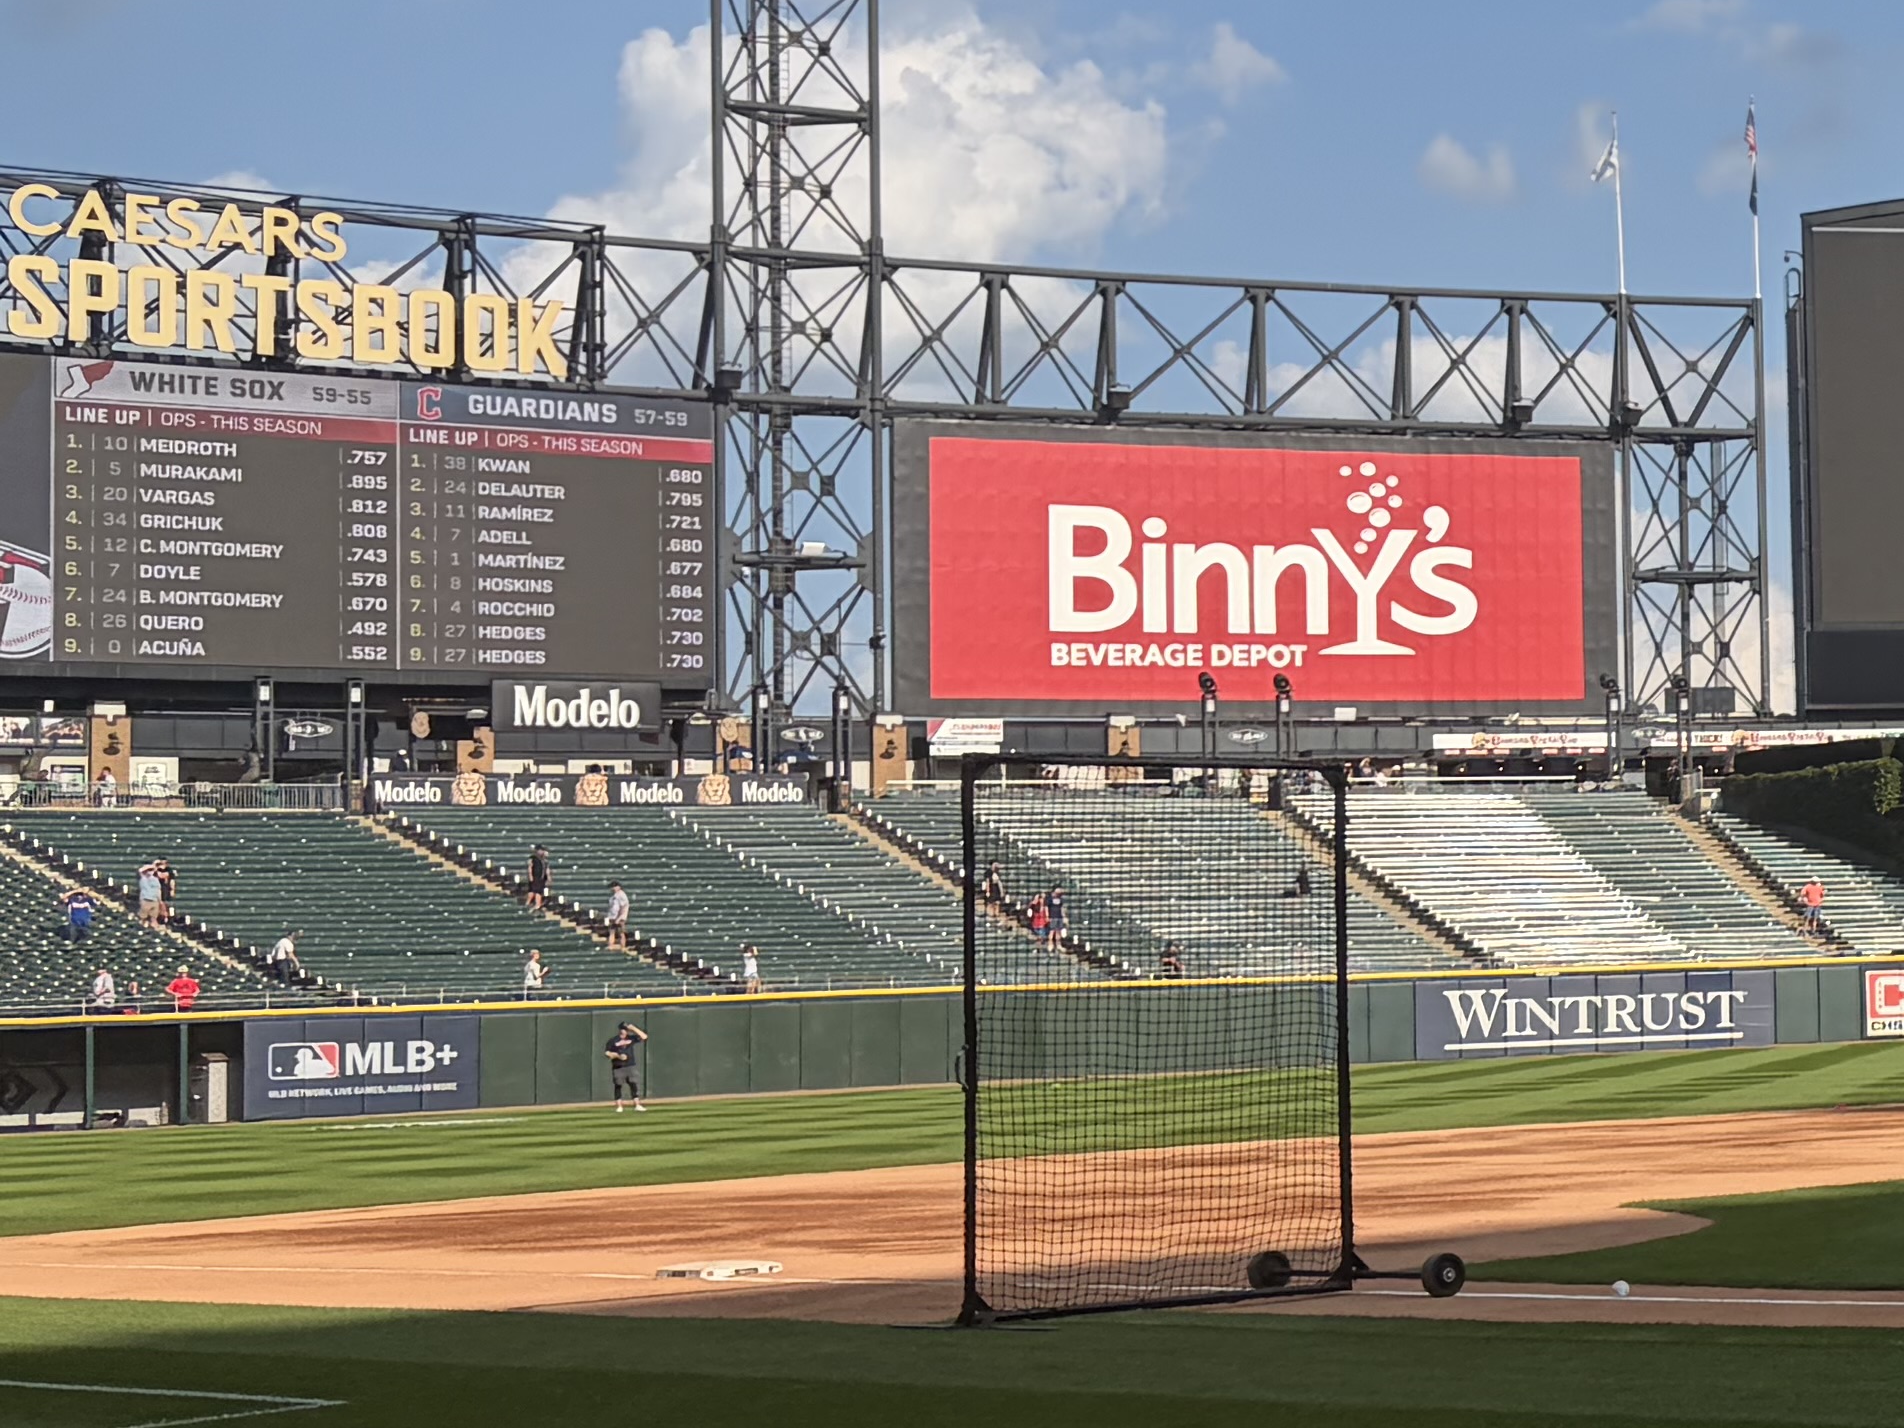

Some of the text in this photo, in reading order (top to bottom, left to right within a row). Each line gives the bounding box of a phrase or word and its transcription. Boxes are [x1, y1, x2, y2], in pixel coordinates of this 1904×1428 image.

[8, 184, 348, 263] CAESARS
[7, 254, 568, 381] SPORTSBOOK
[129, 370, 372, 405] WHITE SOX 59-55
[469, 394, 687, 426] GUARDIANS 57-59
[65, 407, 322, 435] LINE UP OPS THIS SEASON
[140, 438, 237, 457] MEIDROTH
[409, 428, 643, 455] LINE UP OPS THIS SEASON
[140, 463, 242, 482] MURAKAMI
[478, 459, 530, 473] KWAN
[139, 489, 215, 505] VARGAS
[478, 482, 565, 499] DELAUTER
[140, 514, 223, 531] GRICHUK
[478, 505, 554, 522] RAMÍREZ
[478, 531, 532, 544] ADELL
[140, 539, 283, 558] C. MONTGOMERY
[478, 552, 565, 570] MARTÍNEZ
[140, 564, 201, 580] DOYLE
[478, 578, 553, 593] HOSKINS
[140, 590, 283, 609] B. MONTGOMERY
[140, 615, 204, 631] QUERO
[478, 626, 545, 641] HEDGES
[139, 637, 205, 656] ACUÑA
[1050, 641, 1307, 668] BEVERAGE DEPOT
[478, 650, 545, 664] HEDGES
[513, 684, 640, 729] Modelo
[375, 780, 442, 803] Modelo
[497, 781, 562, 804] Modelo
[620, 782, 684, 803] Modelo
[742, 782, 804, 803] Modelo
[345, 1040, 458, 1075] MLB+
